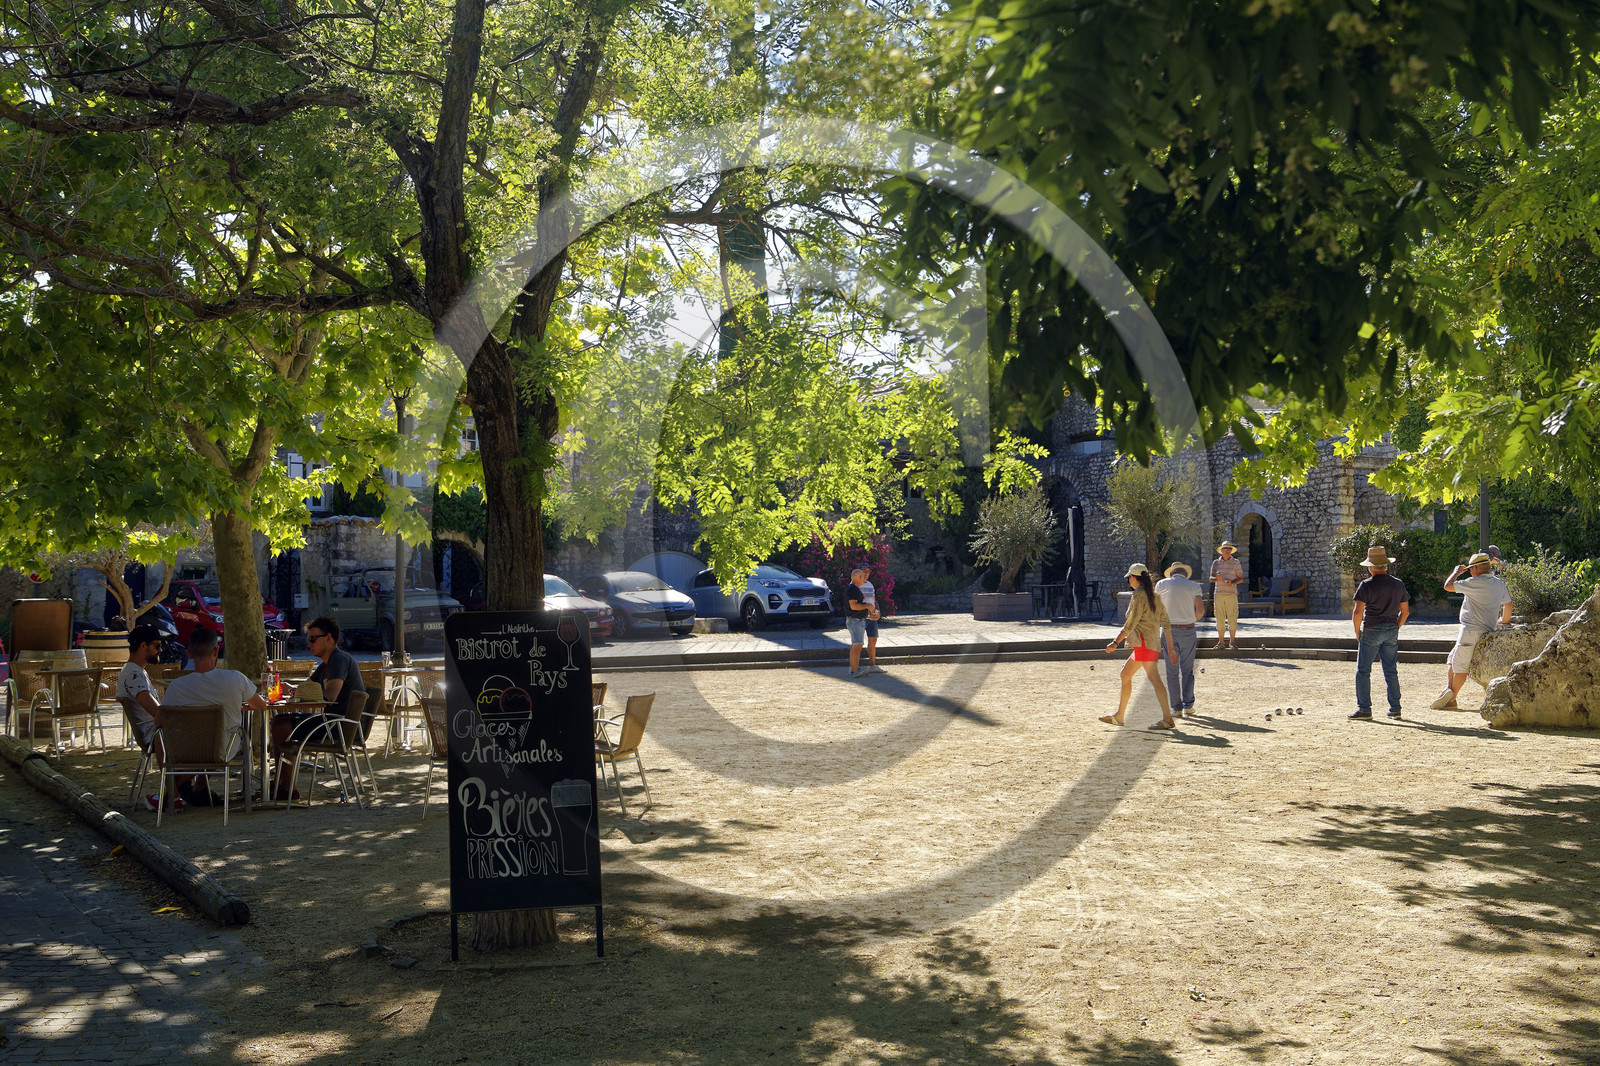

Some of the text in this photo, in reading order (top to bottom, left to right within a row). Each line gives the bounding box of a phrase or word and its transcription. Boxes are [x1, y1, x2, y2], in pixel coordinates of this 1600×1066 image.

[501, 623, 536, 634] L'Absinthe
[456, 637, 547, 660] Bistrot de
[528, 660, 568, 695] Pays
[452, 709, 517, 738] Glaces
[462, 738, 563, 764] Artisanales
[457, 777, 552, 837] Bières
